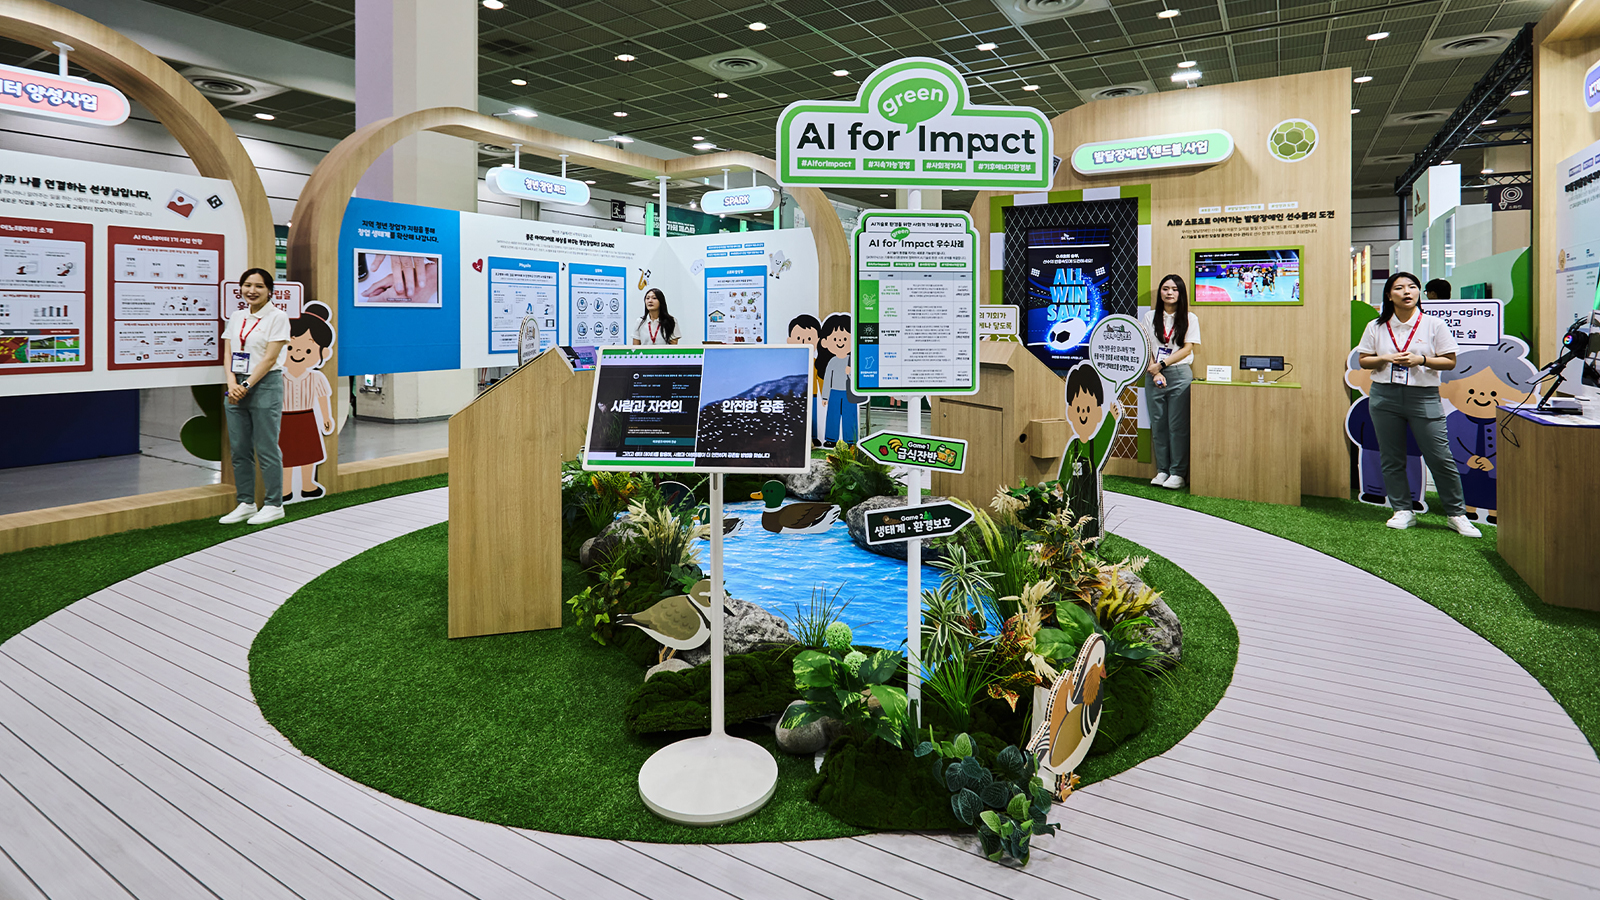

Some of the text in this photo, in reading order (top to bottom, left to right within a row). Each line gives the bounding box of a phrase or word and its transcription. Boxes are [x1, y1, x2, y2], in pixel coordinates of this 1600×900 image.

[0, 78, 98, 112] 터 양성사업
[882, 87, 944, 117] green
[797, 122, 1036, 159] AI for Impact
[1093, 145, 1148, 165] 발달장애인
[1183, 139, 1209, 155] 사업
[801, 159, 852, 168] #AIforImpact
[868, 160, 911, 170] #지속가능경영
[925, 161, 963, 170] #사회적가치
[977, 162, 1032, 172] #기후에너지환경부
[0, 174, 152, 200] 과 나를 연결하는 선생님입니다.
[524, 177, 567, 195] 청년 창업 파크
[723, 194, 750, 207] SPARK
[1212, 215, 1242, 223] 이어가는
[1244, 213, 1283, 223] 발달장애인
[1286, 211, 1317, 221] 선수들의
[1319, 210, 1335, 218] 도전
[376, 221, 387, 229] 청년
[891, 229, 909, 238] green
[869, 239, 964, 249] AI for Impact 우수사례
[1053, 267, 1085, 285] ALL
[271, 290, 291, 300] 립을
[1049, 286, 1088, 303] WIN
[987, 311, 1007, 319] 기회가
[1046, 304, 1091, 322] SAVE
[1467, 330, 1477, 338] 삶
[610, 399, 785, 413] 사람과 자연의 안전한 공존
[908, 441, 926, 449] Game
[897, 447, 938, 463] 급식잔반
[874, 517, 952, 538] 생태계 환경보호
